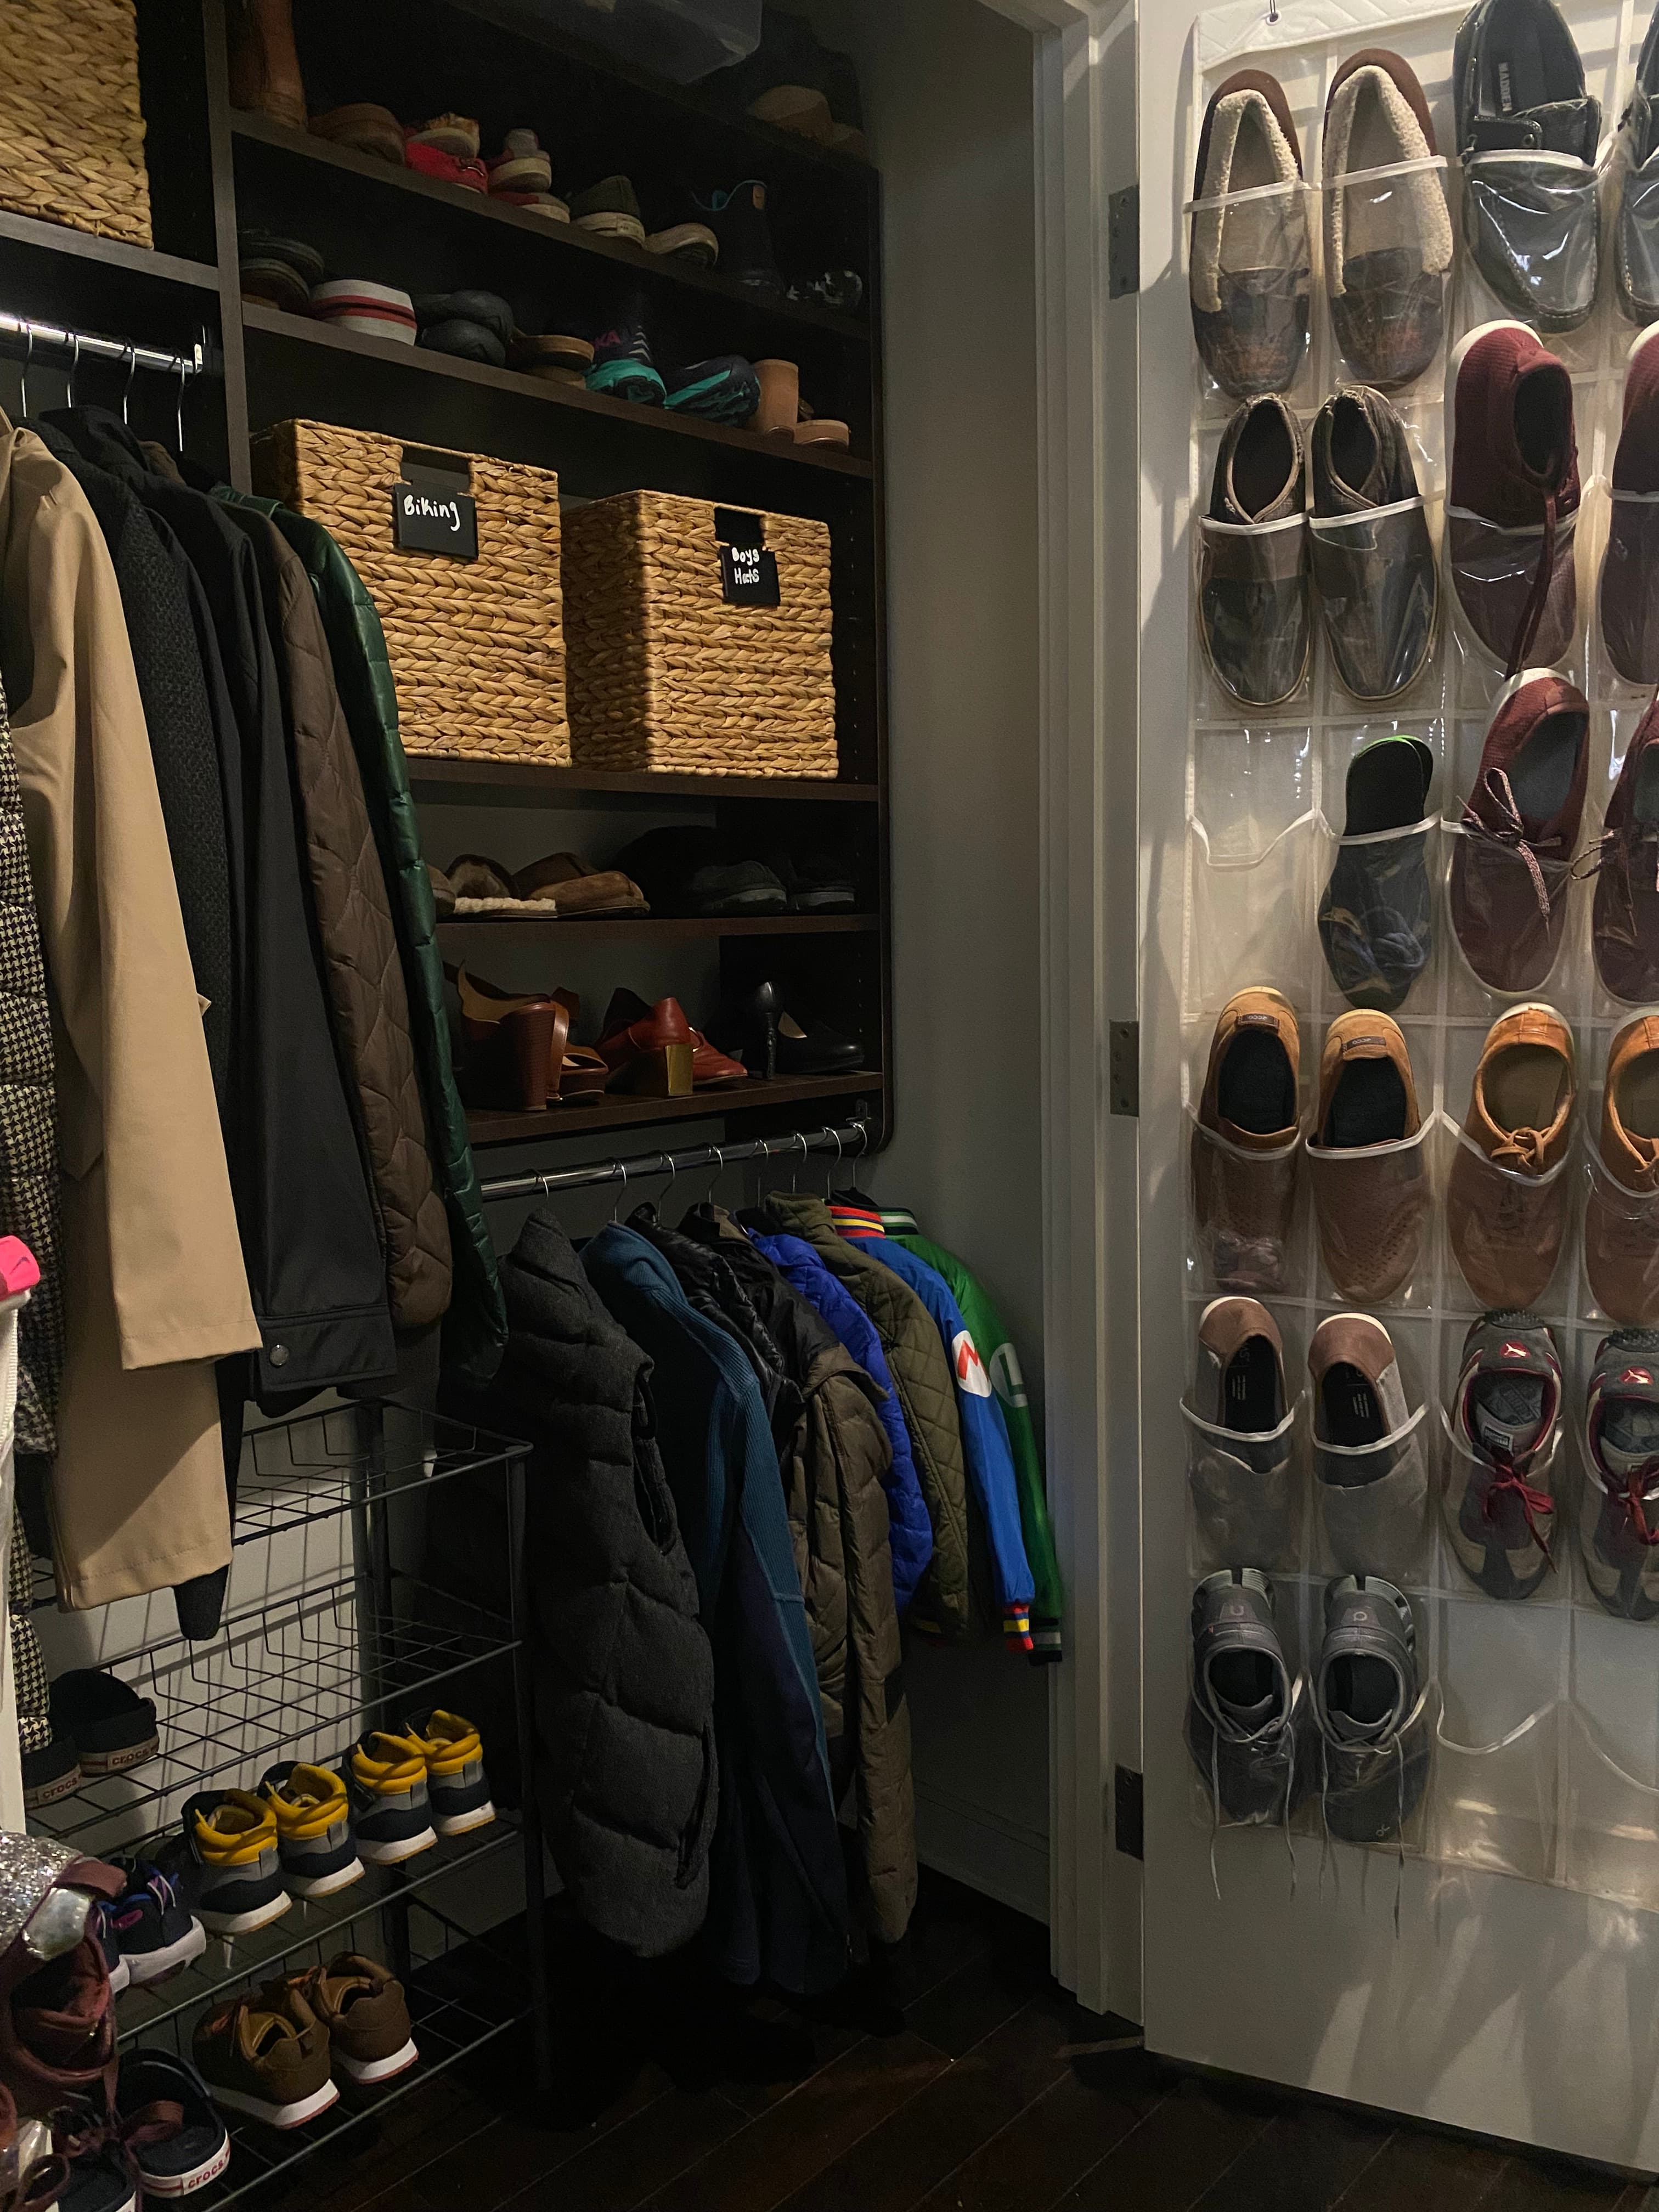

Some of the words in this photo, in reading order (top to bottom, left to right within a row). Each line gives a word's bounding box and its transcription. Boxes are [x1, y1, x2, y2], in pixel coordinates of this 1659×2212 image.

[1498, 62, 1513, 112] MADDEN
[957, 1340, 989, 1383] M
[998, 1352, 1023, 1398] L
[43, 1778, 77, 1798] crocs
[188, 2159, 223, 2188] crocs
